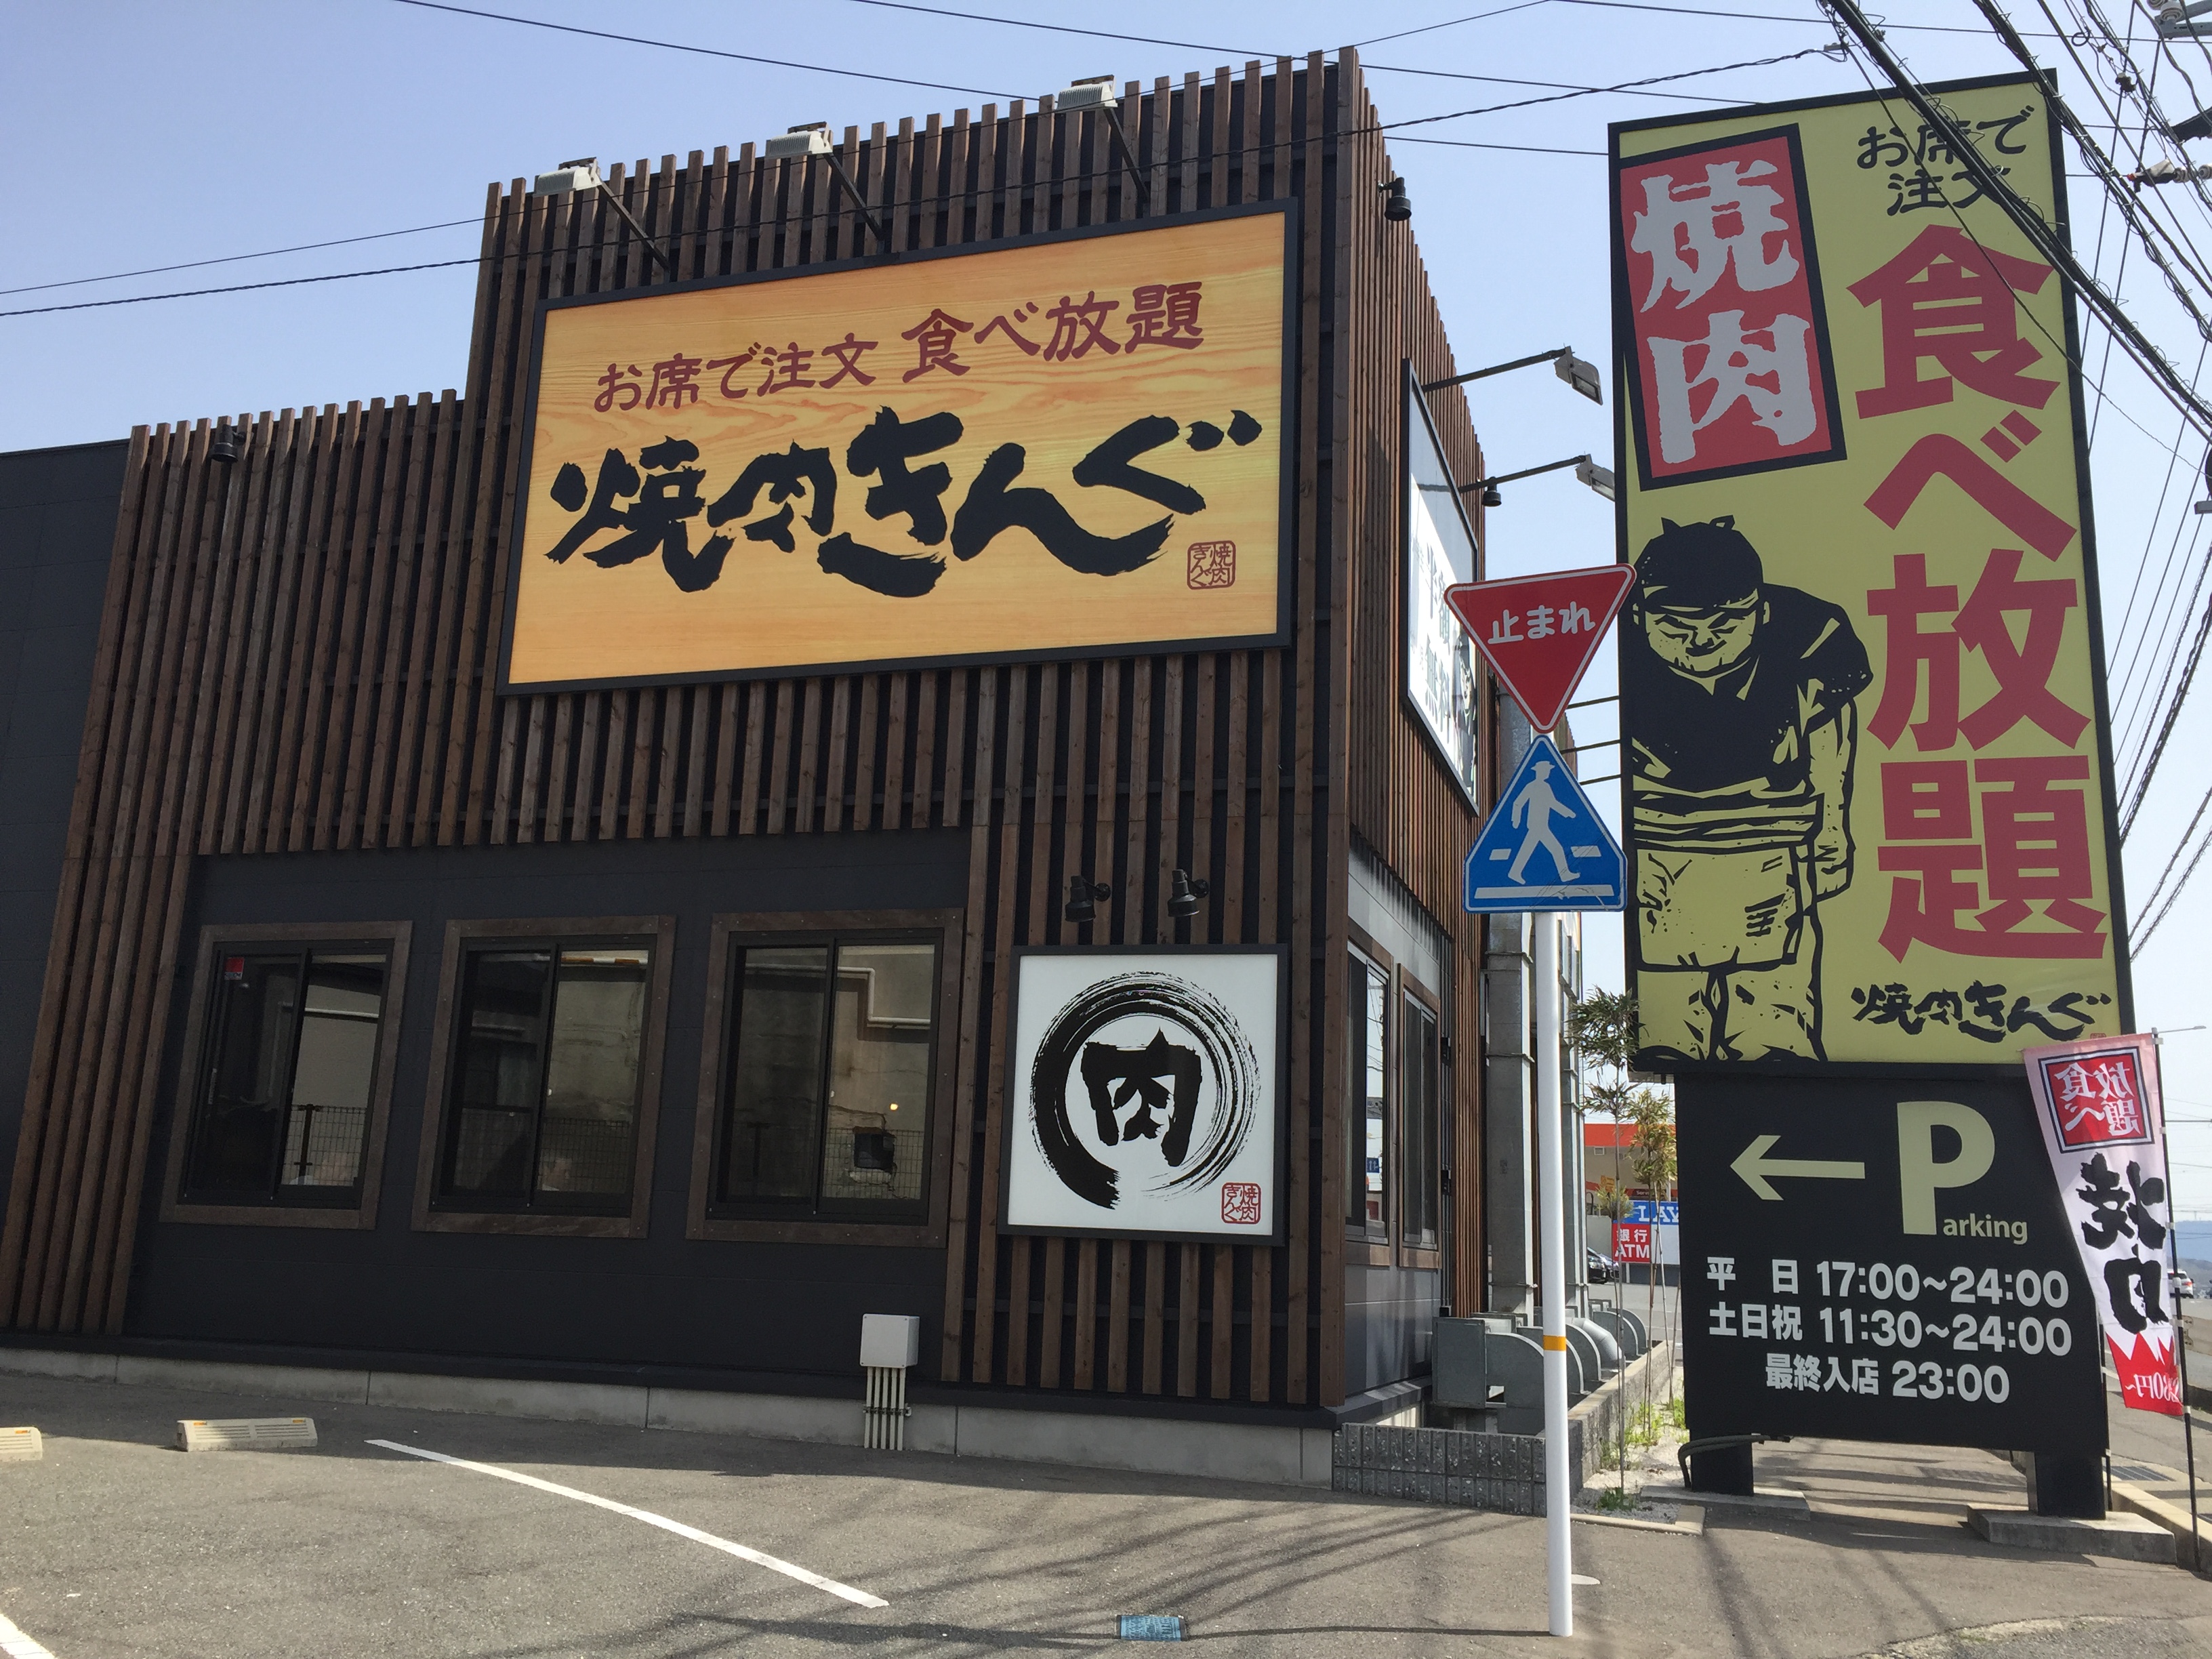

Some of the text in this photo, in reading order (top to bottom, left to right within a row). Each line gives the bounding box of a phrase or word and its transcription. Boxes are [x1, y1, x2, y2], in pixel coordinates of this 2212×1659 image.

[594, 281, 1204, 413] お席で注文 食べ放題
[1631, 159, 1818, 464] 焼肉
[544, 405, 1263, 597] 焼肉きんぐ
[1488, 601, 1596, 644] 止まれ
[1846, 224, 2107, 963] 食べ放題
[1851, 979, 2112, 1043] 焼肉きんぐ
[1080, 1027, 1202, 1167] 肉
[1615, 1244, 1650, 1258] ATM
[1708, 1301, 1803, 1342] 土日祝
[1765, 1353, 2010, 1404] 最終入店 23:00
